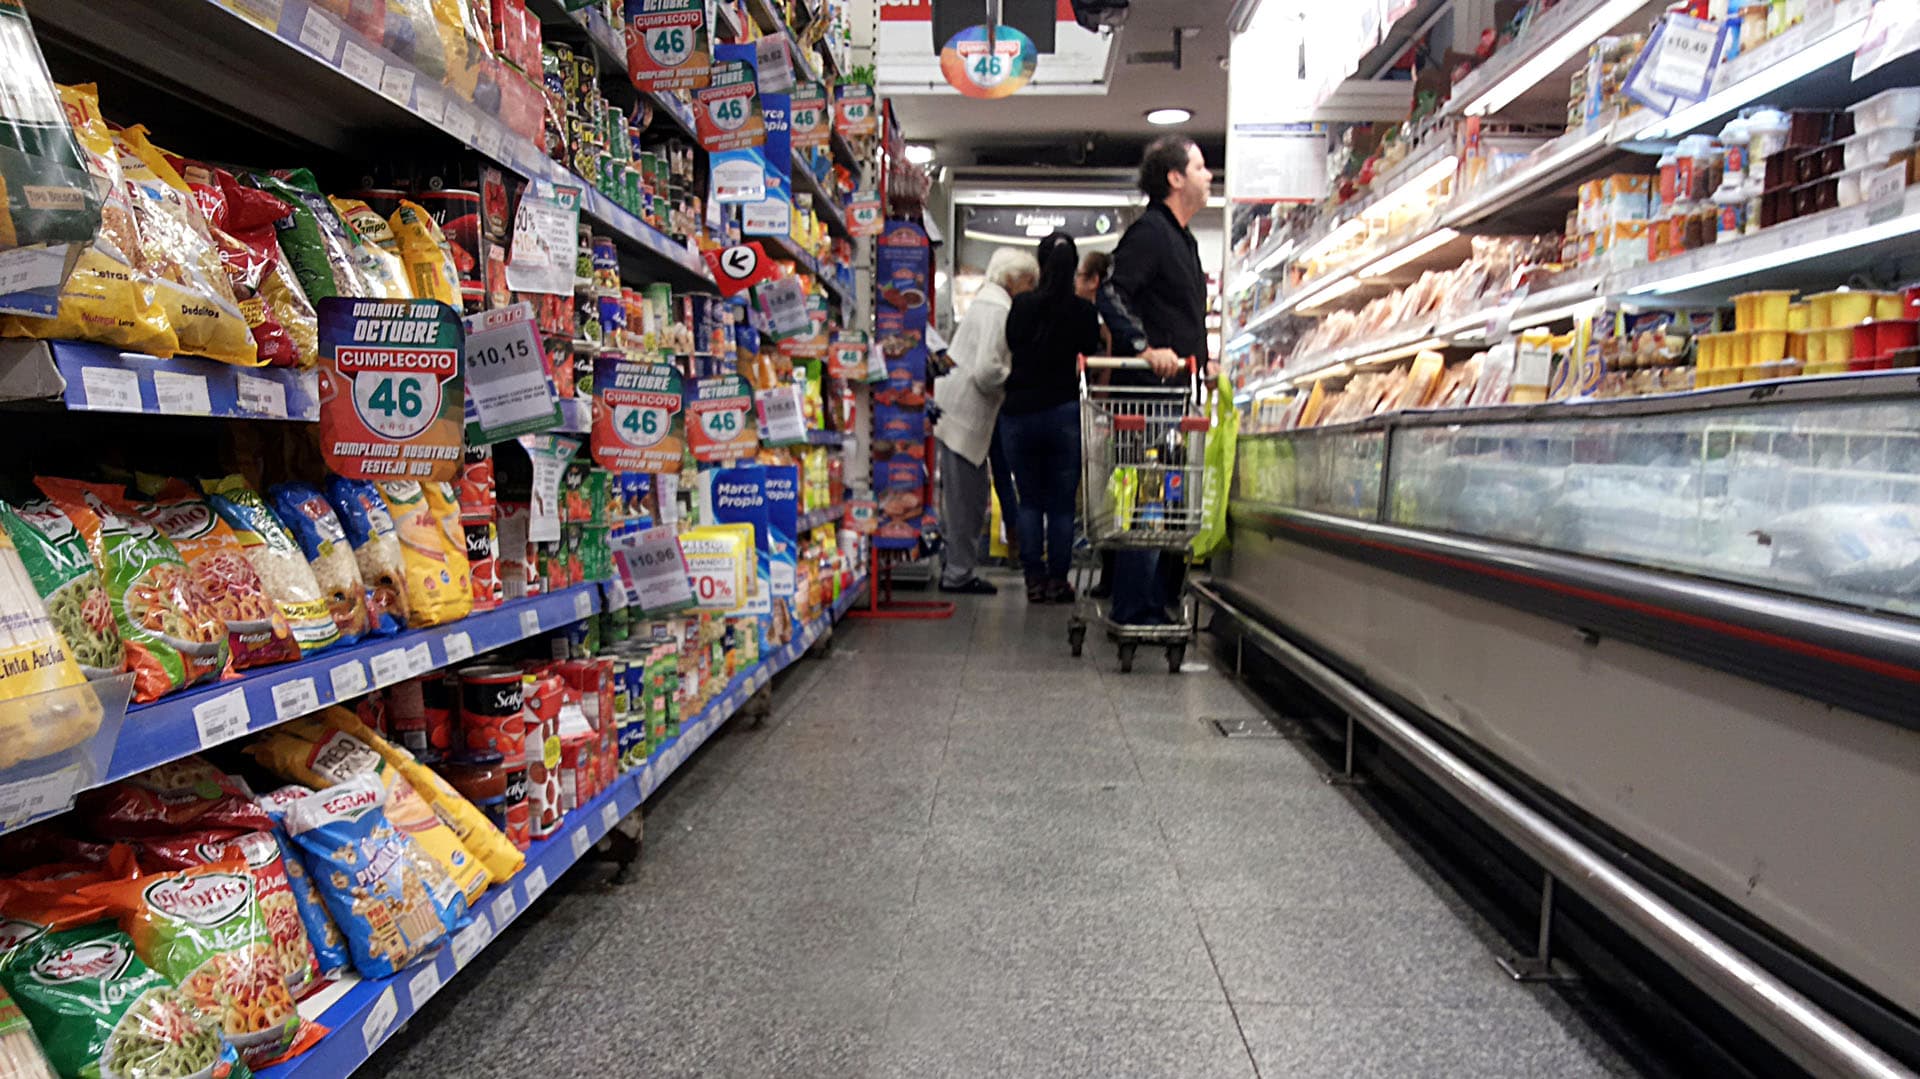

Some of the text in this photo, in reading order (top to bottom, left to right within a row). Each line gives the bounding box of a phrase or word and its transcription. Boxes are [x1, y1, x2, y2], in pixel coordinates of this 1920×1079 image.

[636, 13, 699, 26] CUMPLECOTO
[654, 28, 685, 54] 46
[974, 56, 1000, 76] 46
[717, 99, 742, 121] 46
[795, 110, 814, 125] 46
[848, 106, 864, 117] 46
[857, 209, 872, 219] 46
[92, 268, 129, 281] Letras
[353, 303, 439, 318] DURANTE TODO
[354, 319, 440, 343] OCTUBRE
[341, 351, 451, 369] CUMPLECOTO
[467, 340, 529, 367] $10,15
[842, 352, 857, 361] 46
[615, 373, 671, 391] OCTUBRE
[368, 377, 422, 417] 46
[606, 392, 678, 407] CUMPLECOTO
[622, 409, 657, 434] 46
[710, 411, 735, 432] 46
[333, 442, 400, 457] CUMPLIMOS
[403, 445, 460, 459] NOSOTROS
[360, 460, 433, 475] FESTEJA VOS
[718, 483, 759, 495] Marca
[765, 480, 792, 489] arca
[719, 496, 763, 508] Propia
[855, 508, 868, 517] 46
